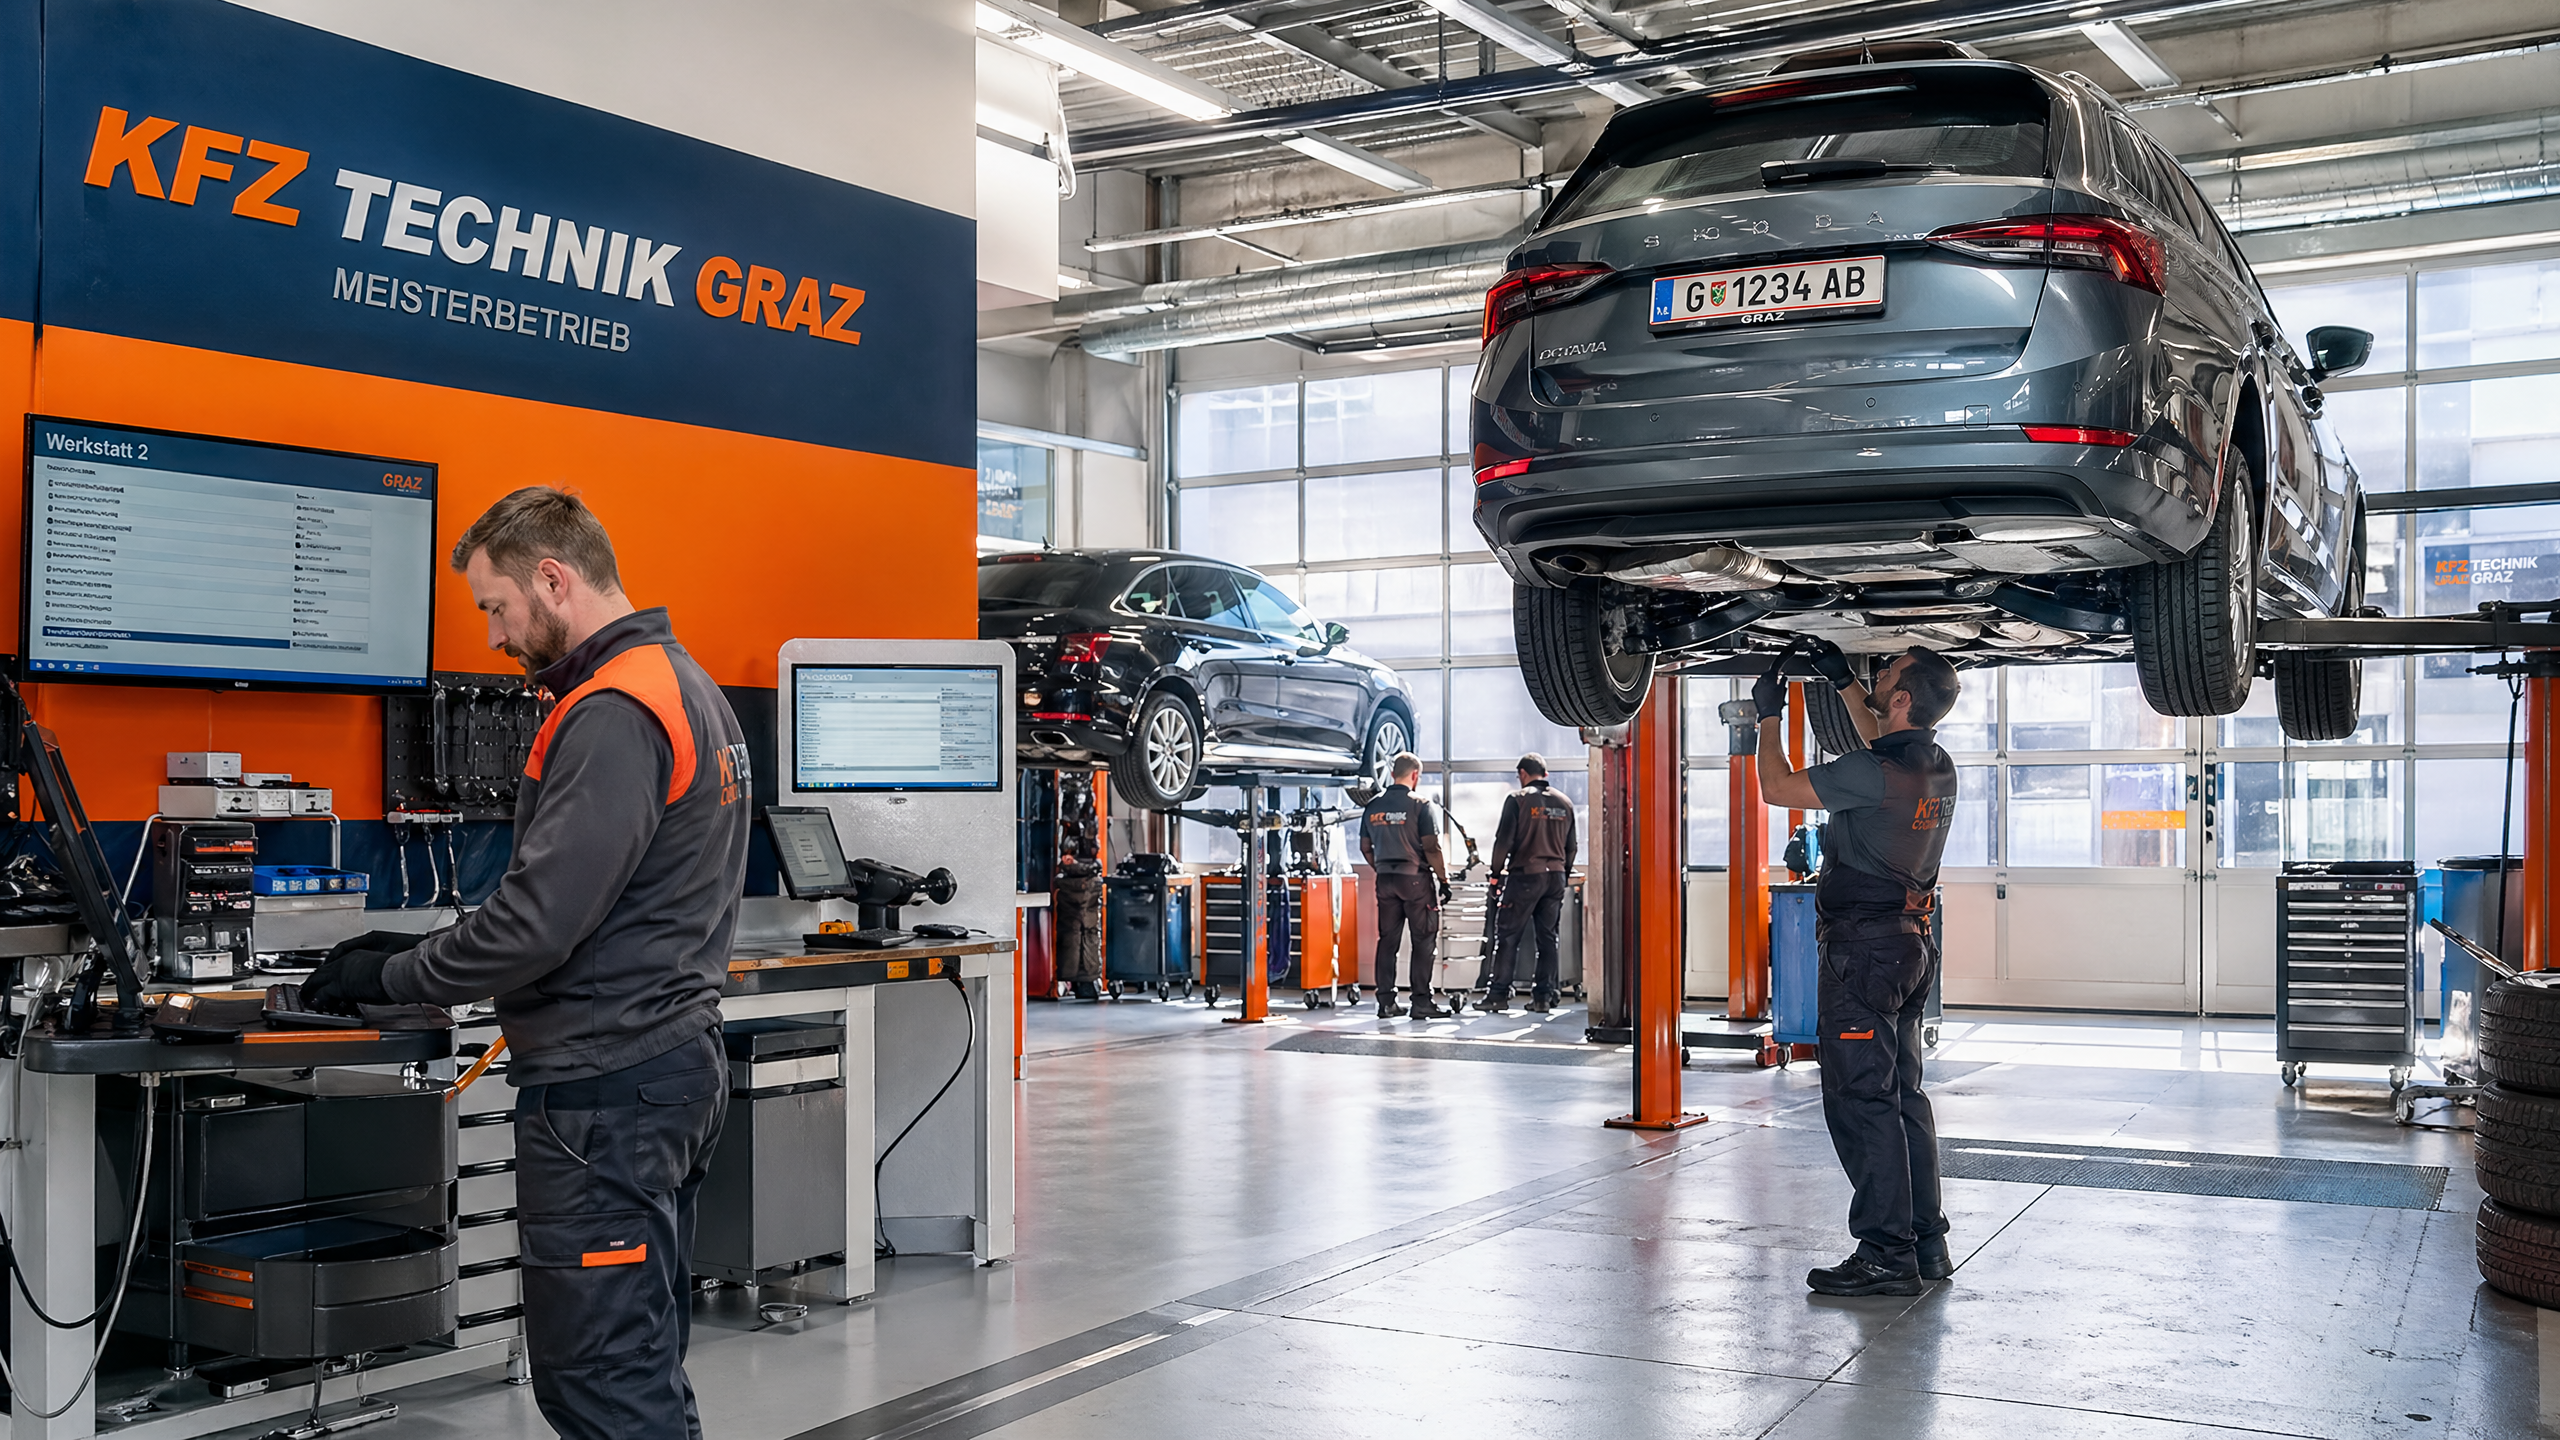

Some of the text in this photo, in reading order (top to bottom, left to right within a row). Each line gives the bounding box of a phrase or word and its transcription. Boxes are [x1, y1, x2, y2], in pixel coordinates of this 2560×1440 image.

[83, 105, 866, 346] KFZ TECHNIK GRAZ
[1686, 265, 1866, 313] G 1234 AB
[333, 267, 632, 353] MEISTERBETRIEB
[1740, 311, 1785, 324] GRAZ
[1539, 341, 1607, 360] OCTAVIA
[46, 432, 149, 461] Werkstatt 2
[382, 472, 423, 490] GRAZ
[2470, 556, 2538, 571] TECHNIK
[2471, 570, 2514, 584] GRAZ
